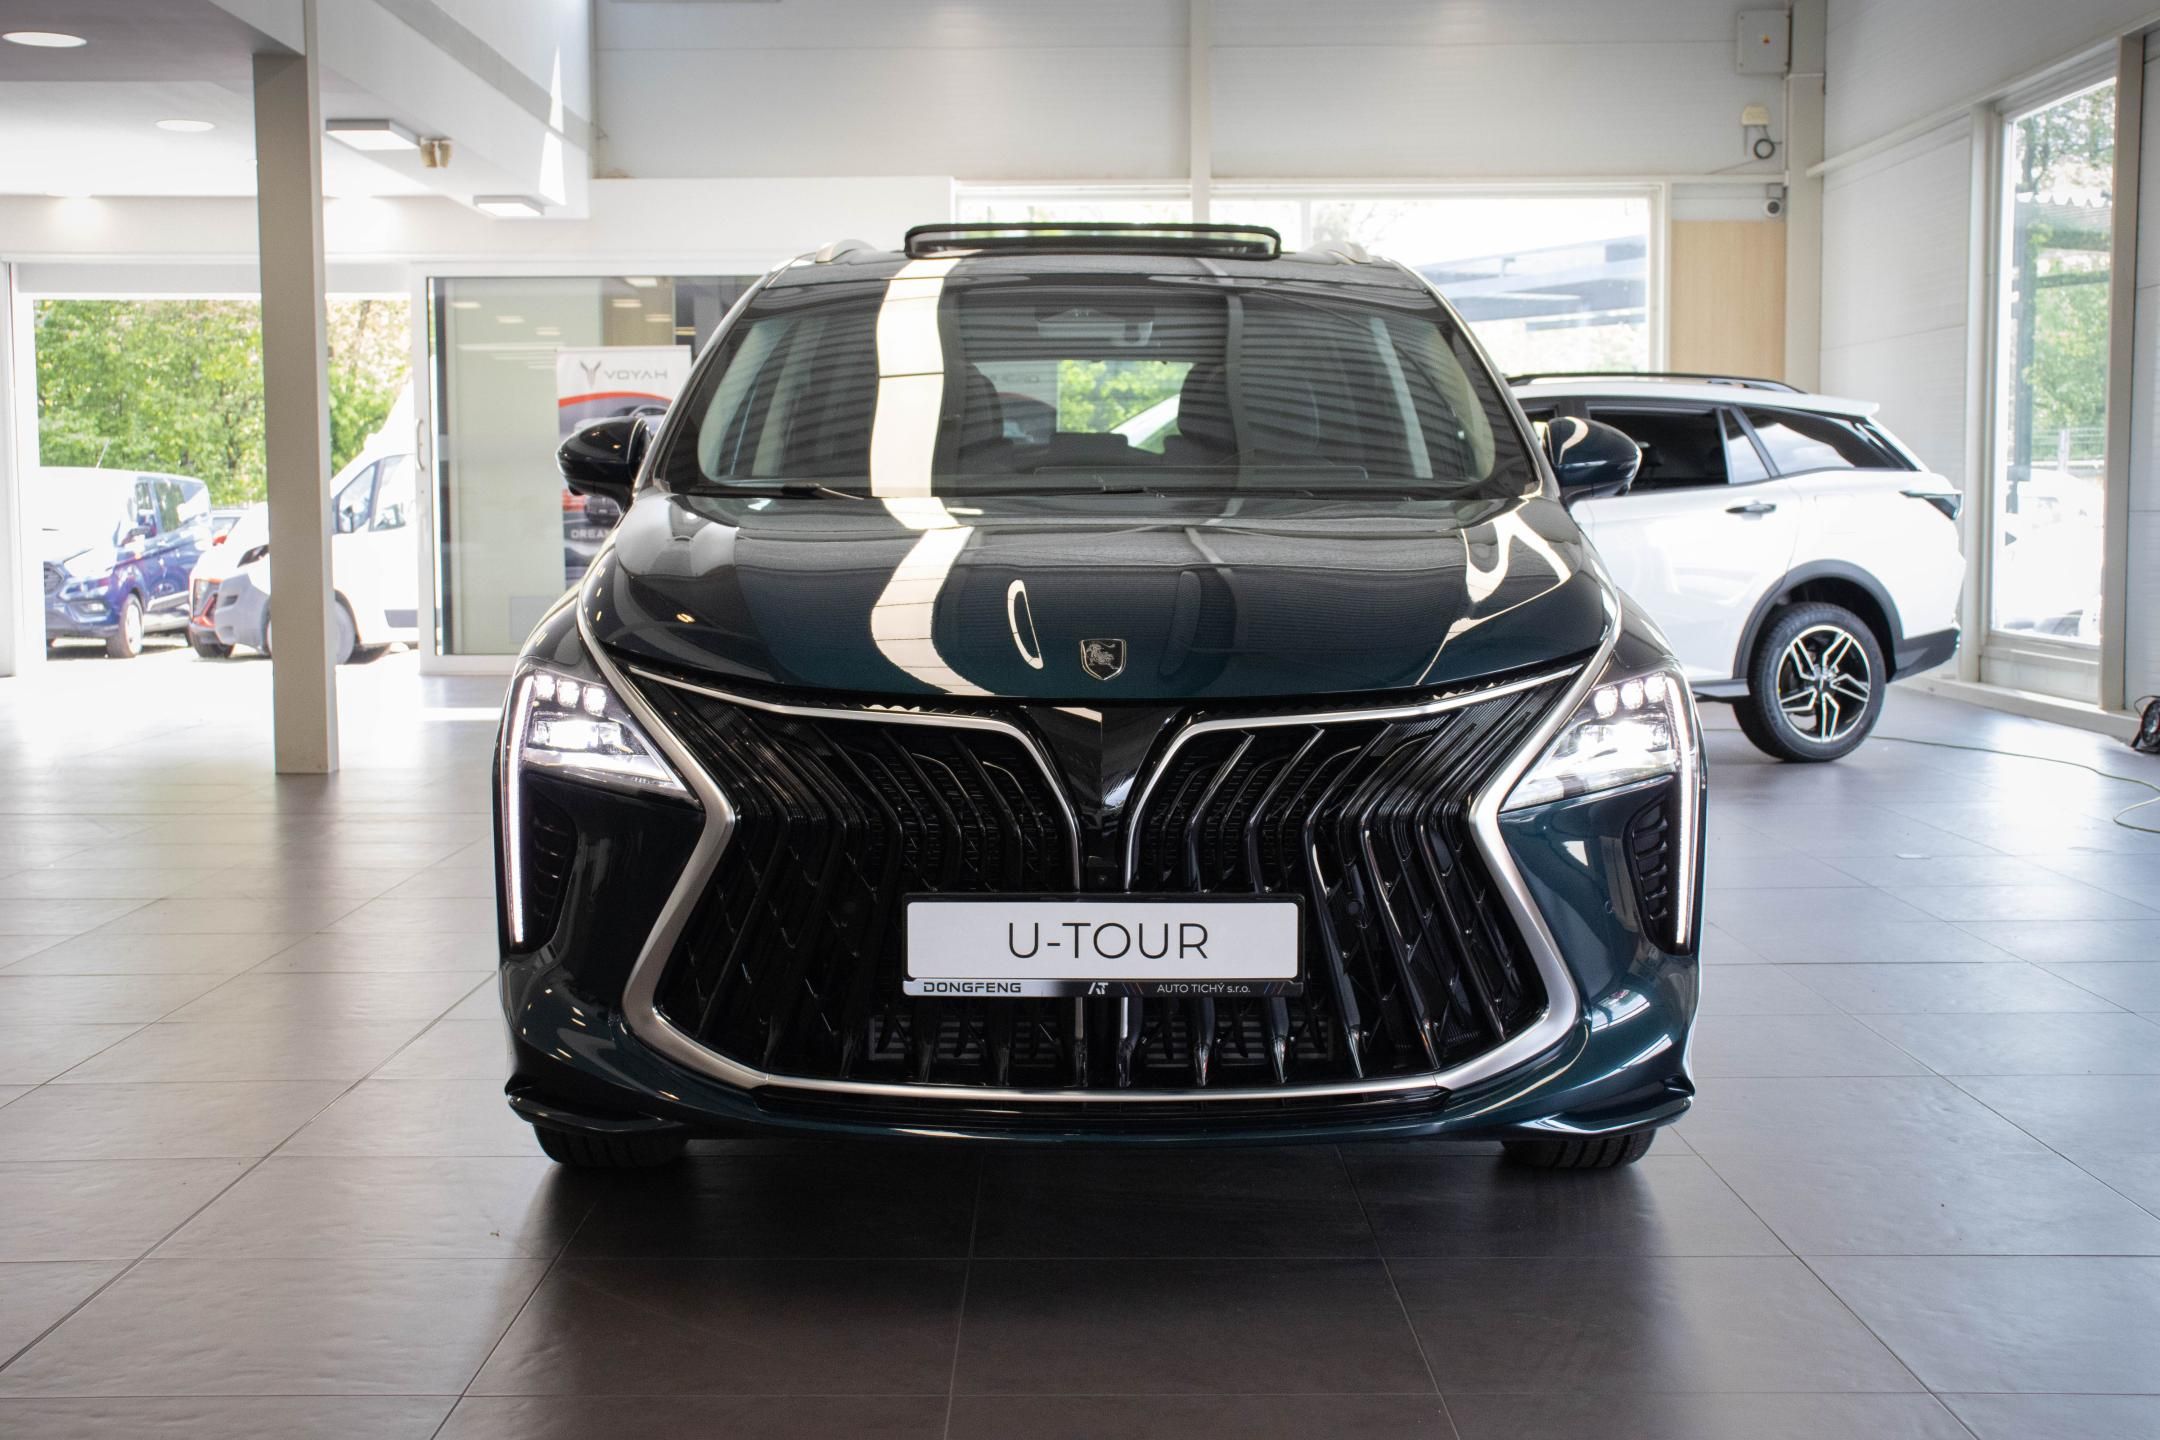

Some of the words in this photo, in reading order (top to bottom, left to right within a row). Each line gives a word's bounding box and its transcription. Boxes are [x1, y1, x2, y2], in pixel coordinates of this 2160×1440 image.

[604, 370, 668, 380] VOYAH
[1008, 922, 1209, 959] U-TOUR
[923, 982, 1022, 993] DONGFENG
[1157, 984, 1189, 993] AUTO
[1191, 982, 1224, 993] TICHÝ
[1227, 984, 1251, 993] s.r.o.
